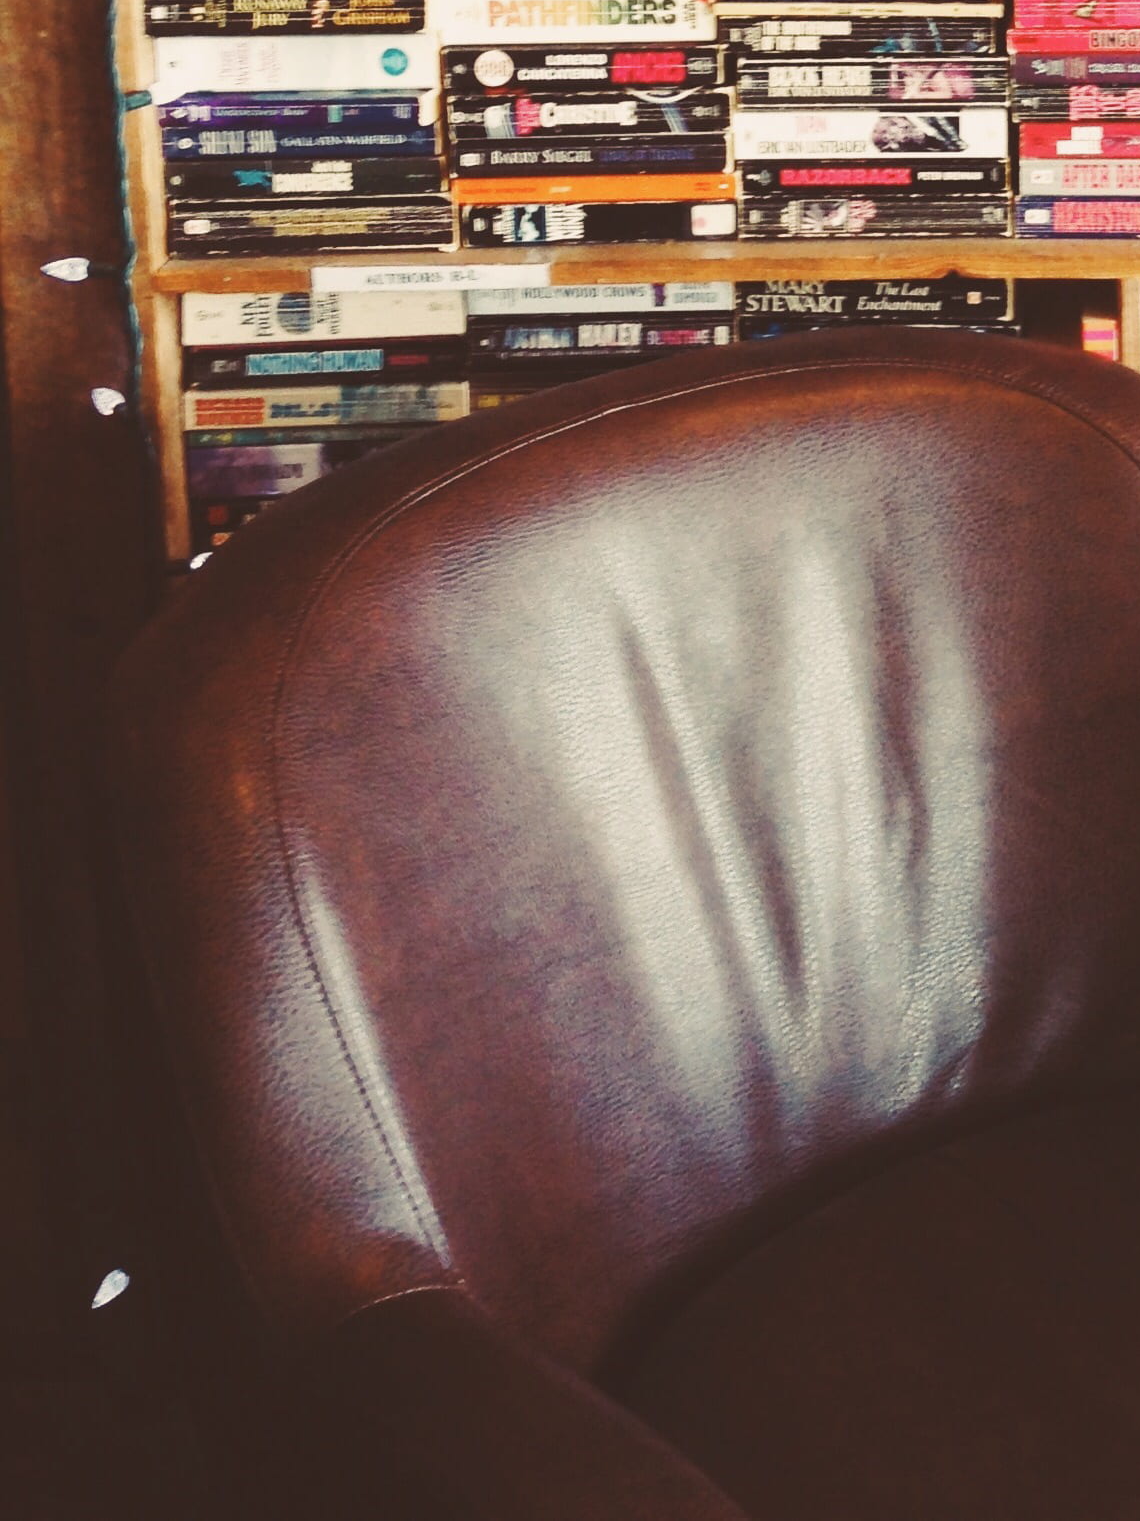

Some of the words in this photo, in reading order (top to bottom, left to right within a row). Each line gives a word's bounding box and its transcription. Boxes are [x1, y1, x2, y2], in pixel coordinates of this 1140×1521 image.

[874, 283, 896, 296] The
[901, 284, 930, 296] Last
[746, 295, 843, 313] STEWART
[857, 297, 941, 313] Enchantment
